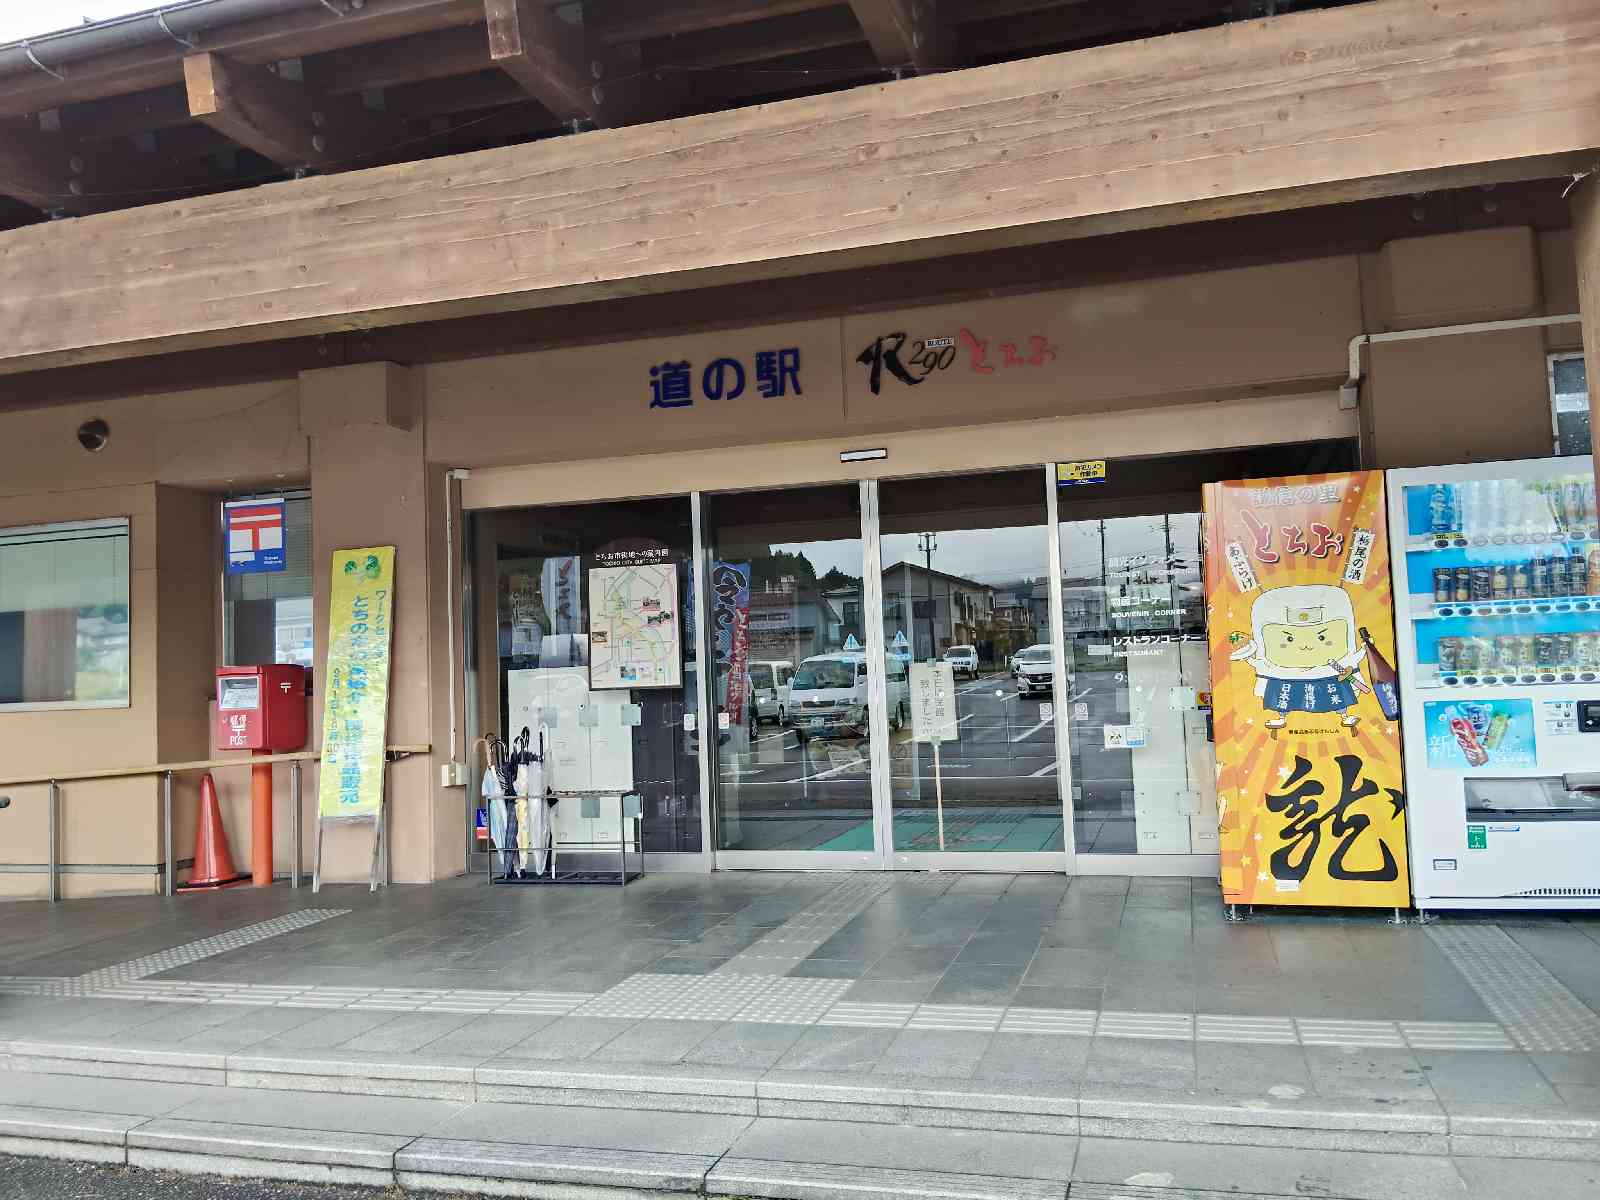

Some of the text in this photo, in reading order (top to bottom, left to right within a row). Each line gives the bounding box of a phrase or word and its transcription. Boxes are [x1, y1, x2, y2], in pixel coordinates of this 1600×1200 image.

[959, 328, 1058, 375] とちお
[649, 348, 803, 410] 道の駅
[1239, 508, 1344, 563] とちお
[1348, 534, 1370, 581] 栃尾の酒
[1155, 608, 1186, 616] CORNER
[1113, 634, 1201, 646] レストランコーナー
[230, 736, 246, 745] POST
